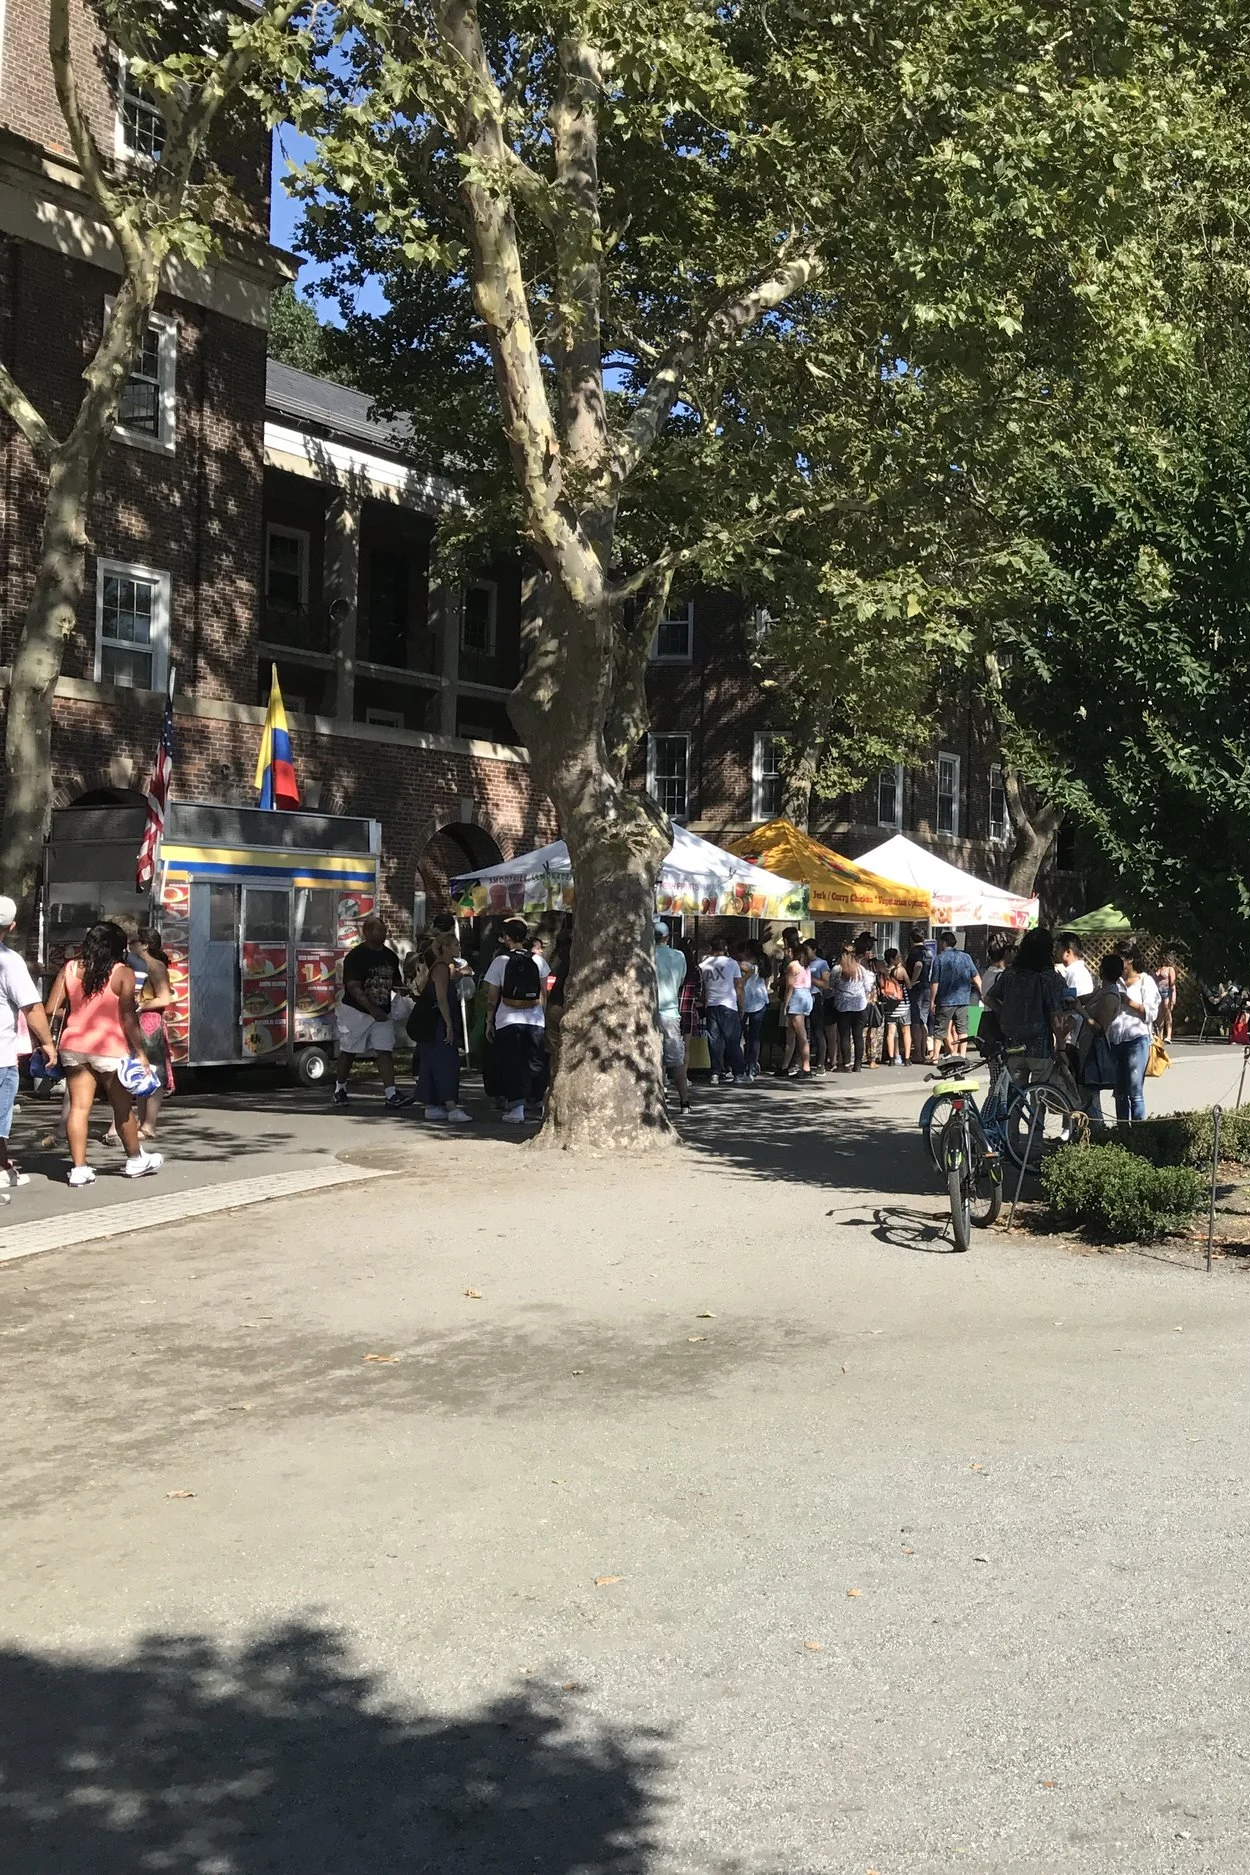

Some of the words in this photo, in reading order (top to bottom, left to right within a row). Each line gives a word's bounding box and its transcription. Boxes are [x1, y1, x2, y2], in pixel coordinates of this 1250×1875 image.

[813, 890, 826, 900] Jerk
[831, 892, 849, 903] Curry
[850, 893, 873, 903] Chicken
[878, 896, 907, 907] Vegetarian
